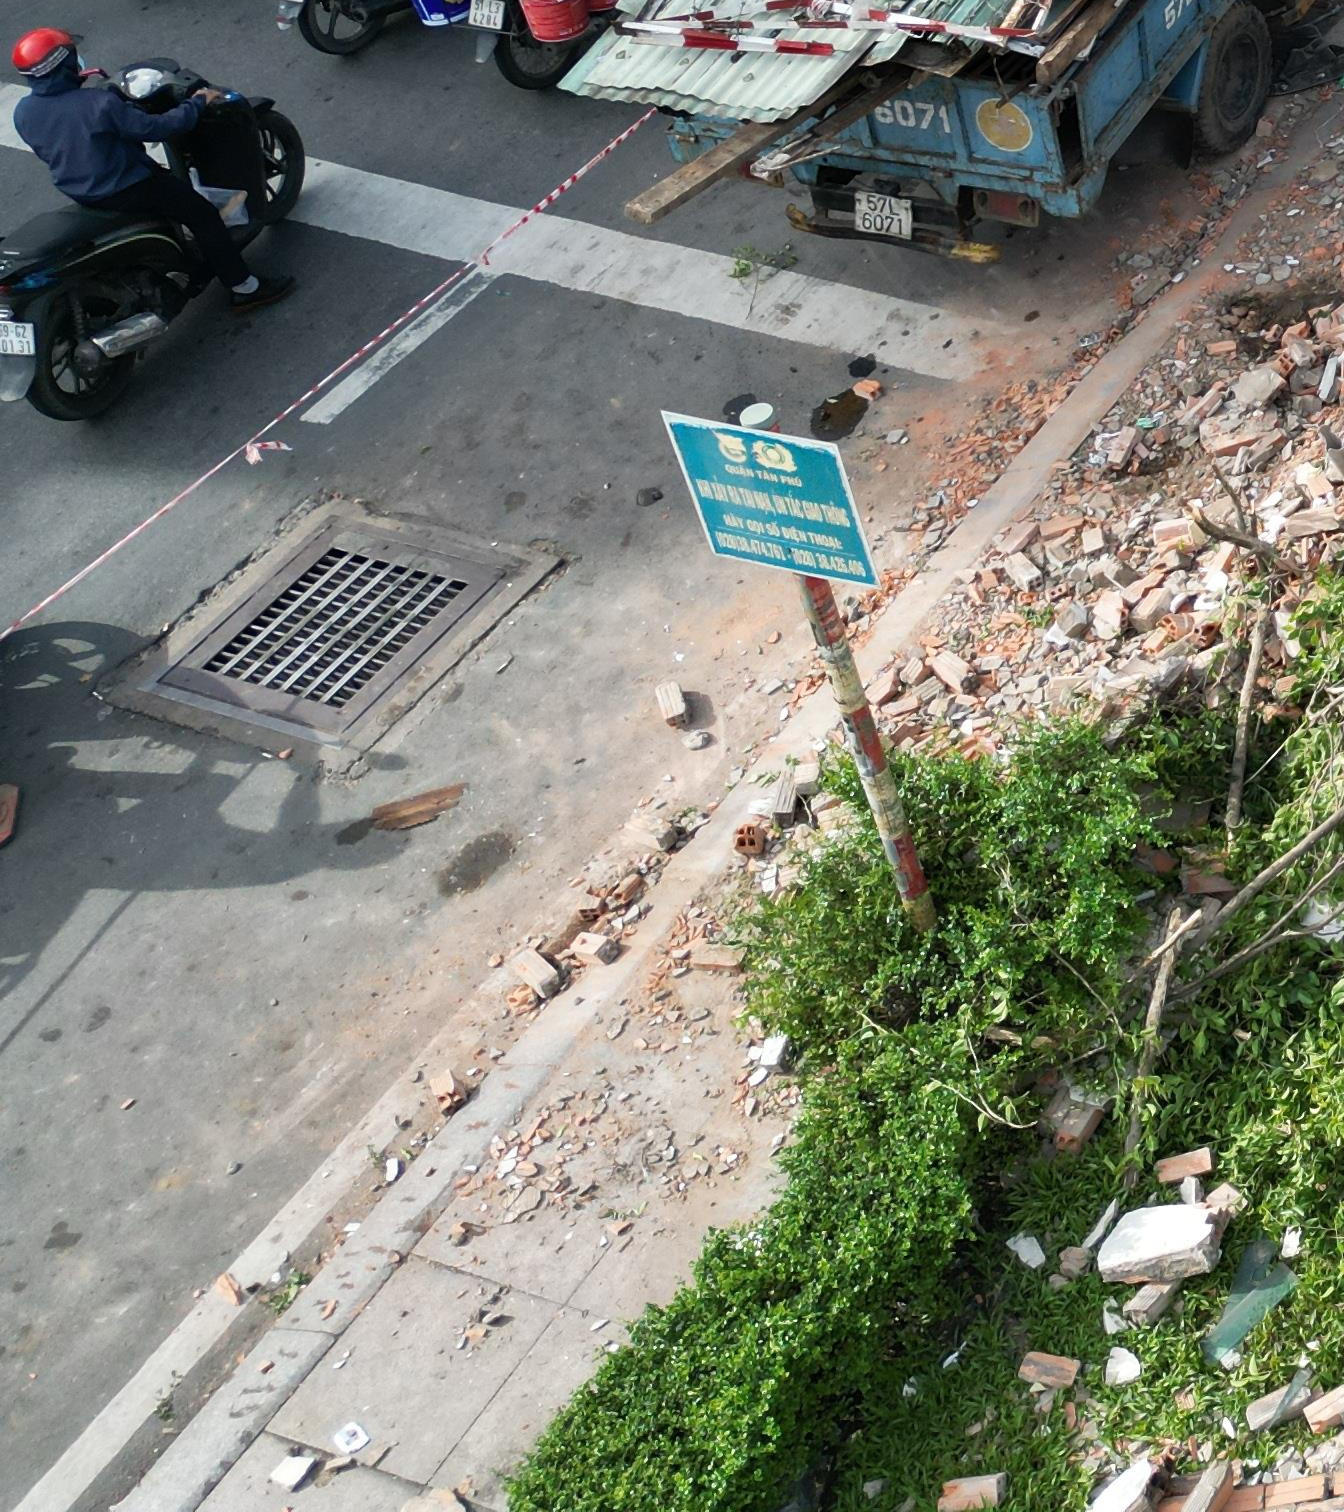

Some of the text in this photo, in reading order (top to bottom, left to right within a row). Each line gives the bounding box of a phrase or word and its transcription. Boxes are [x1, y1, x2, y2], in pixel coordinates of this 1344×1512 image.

[874, 99, 951, 134] 6071
[866, 194, 900, 216] 57L
[862, 212, 903, 236] 6071
